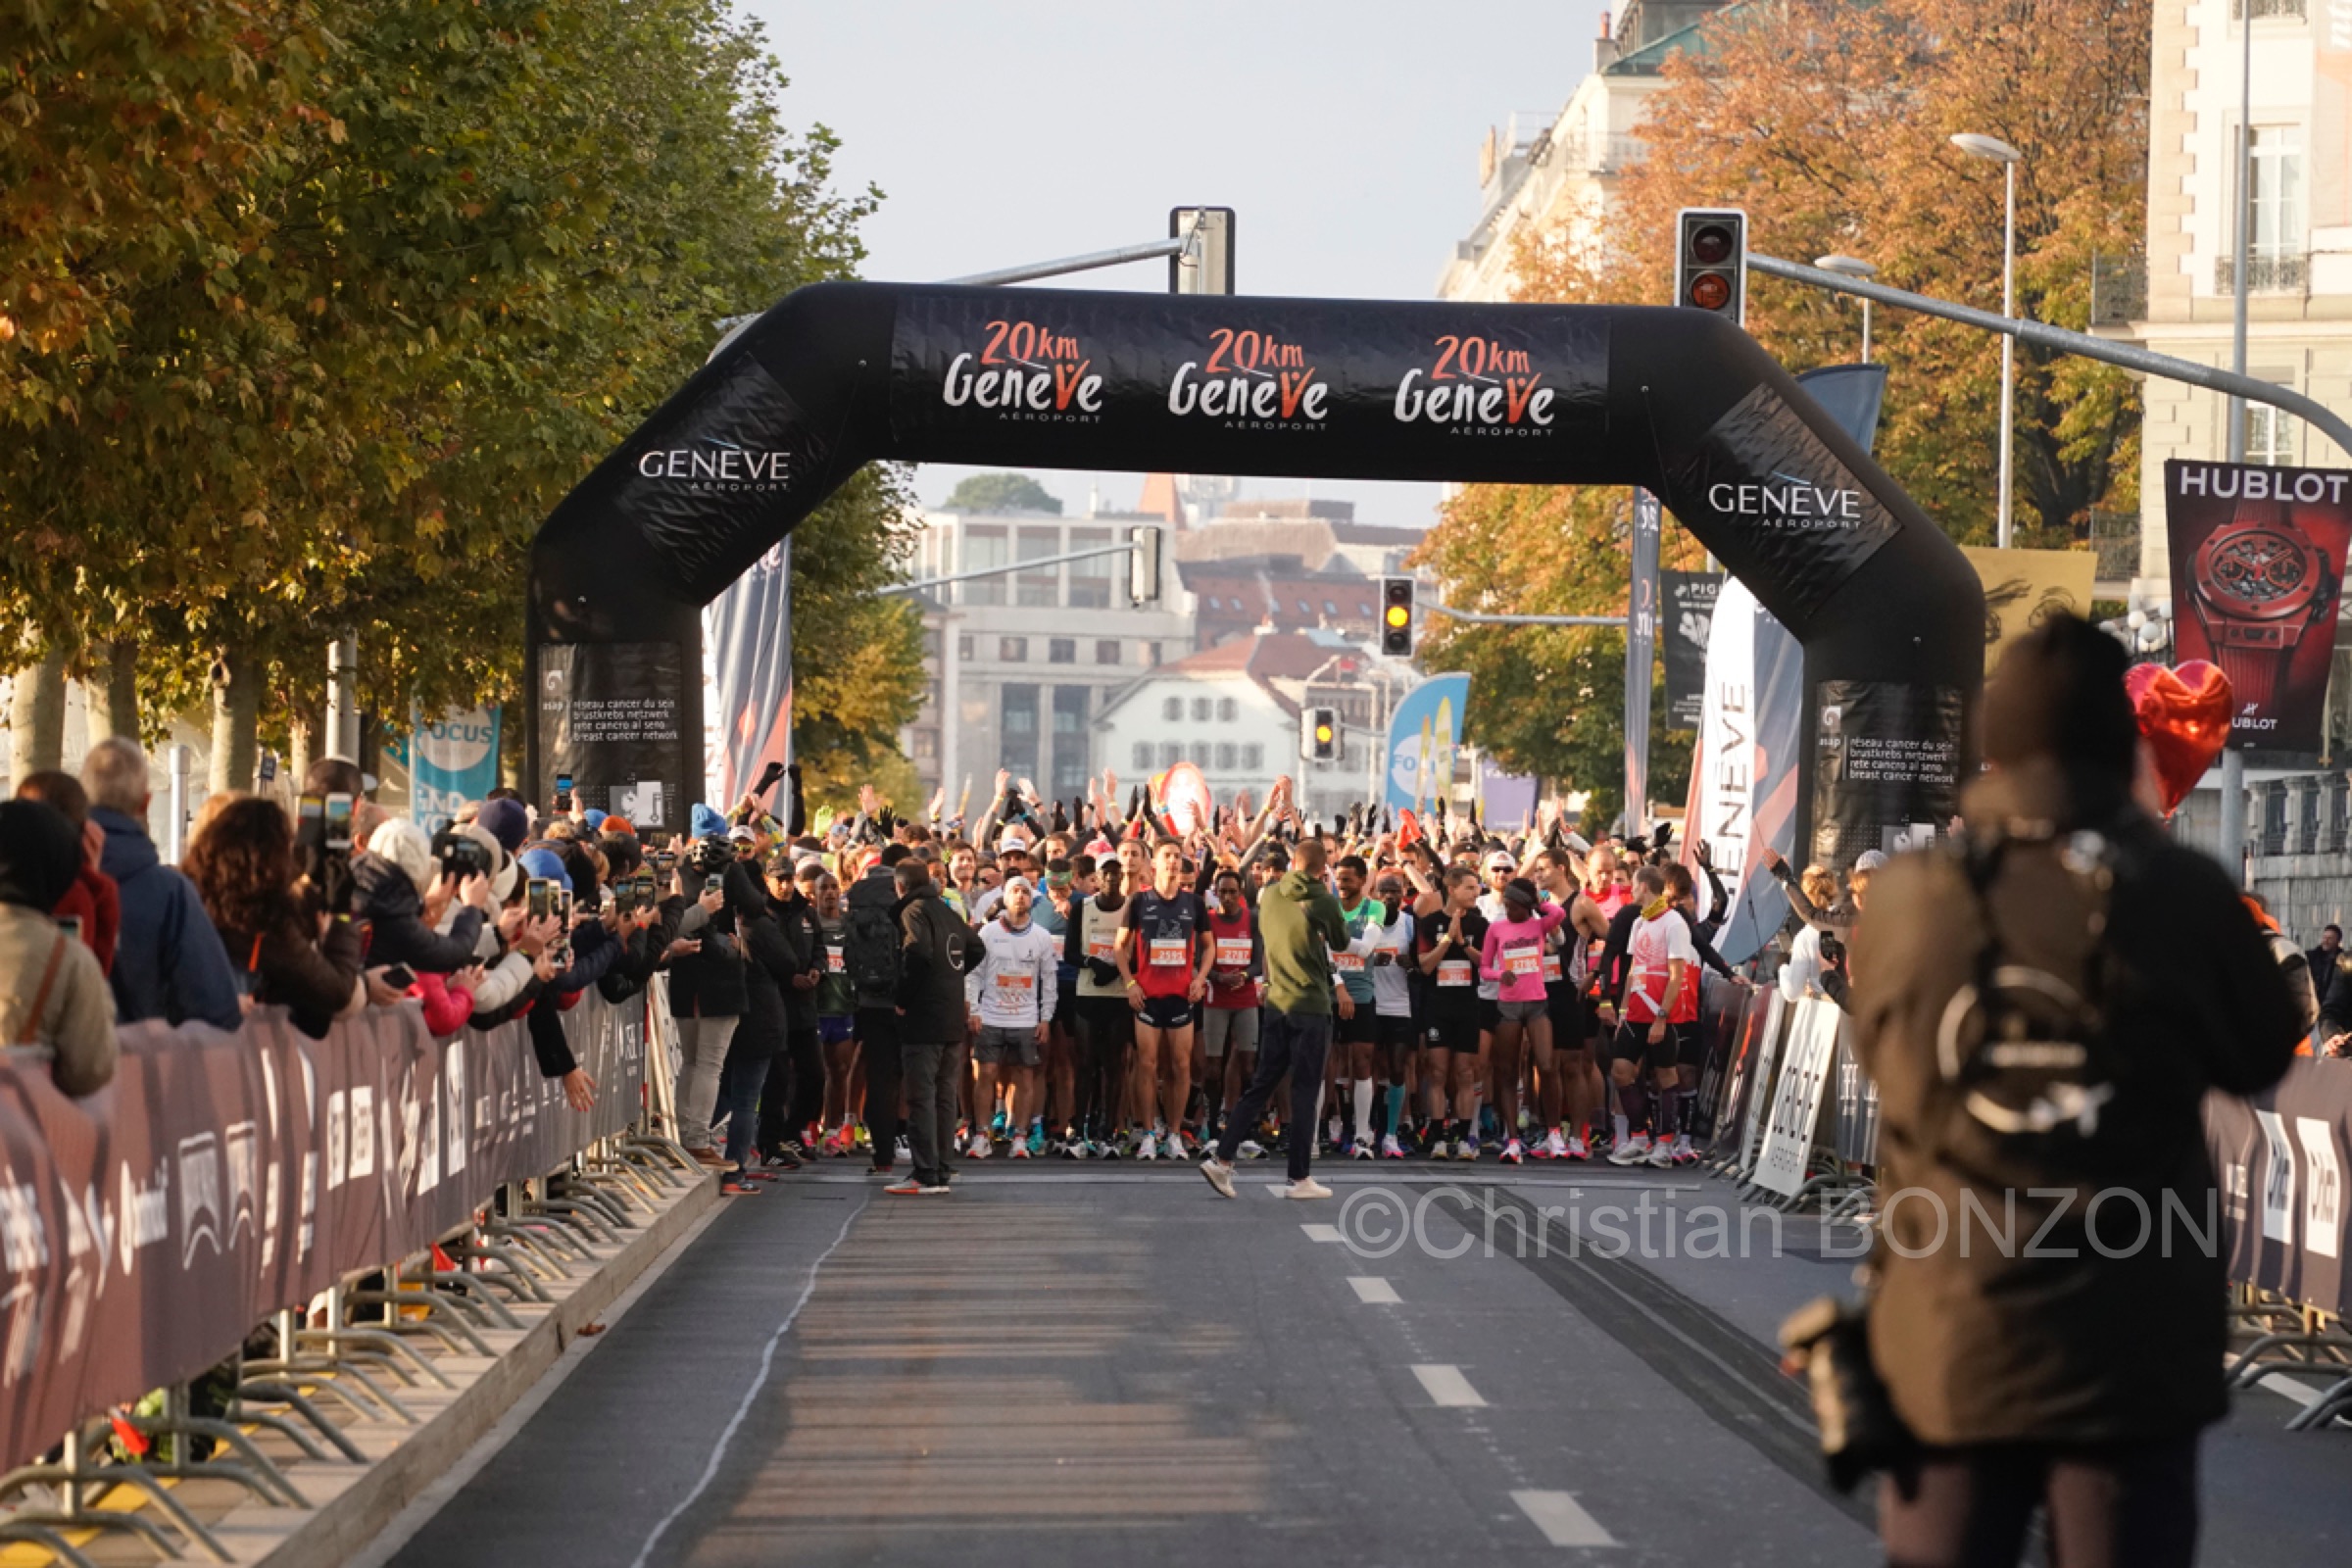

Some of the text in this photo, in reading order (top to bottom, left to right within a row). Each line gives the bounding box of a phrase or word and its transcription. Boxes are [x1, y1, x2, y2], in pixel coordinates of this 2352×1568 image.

[2180, 466, 2349, 504] HUBLOT
[431, 722, 493, 743] OCUS
[2231, 716, 2278, 730] UBLOT
